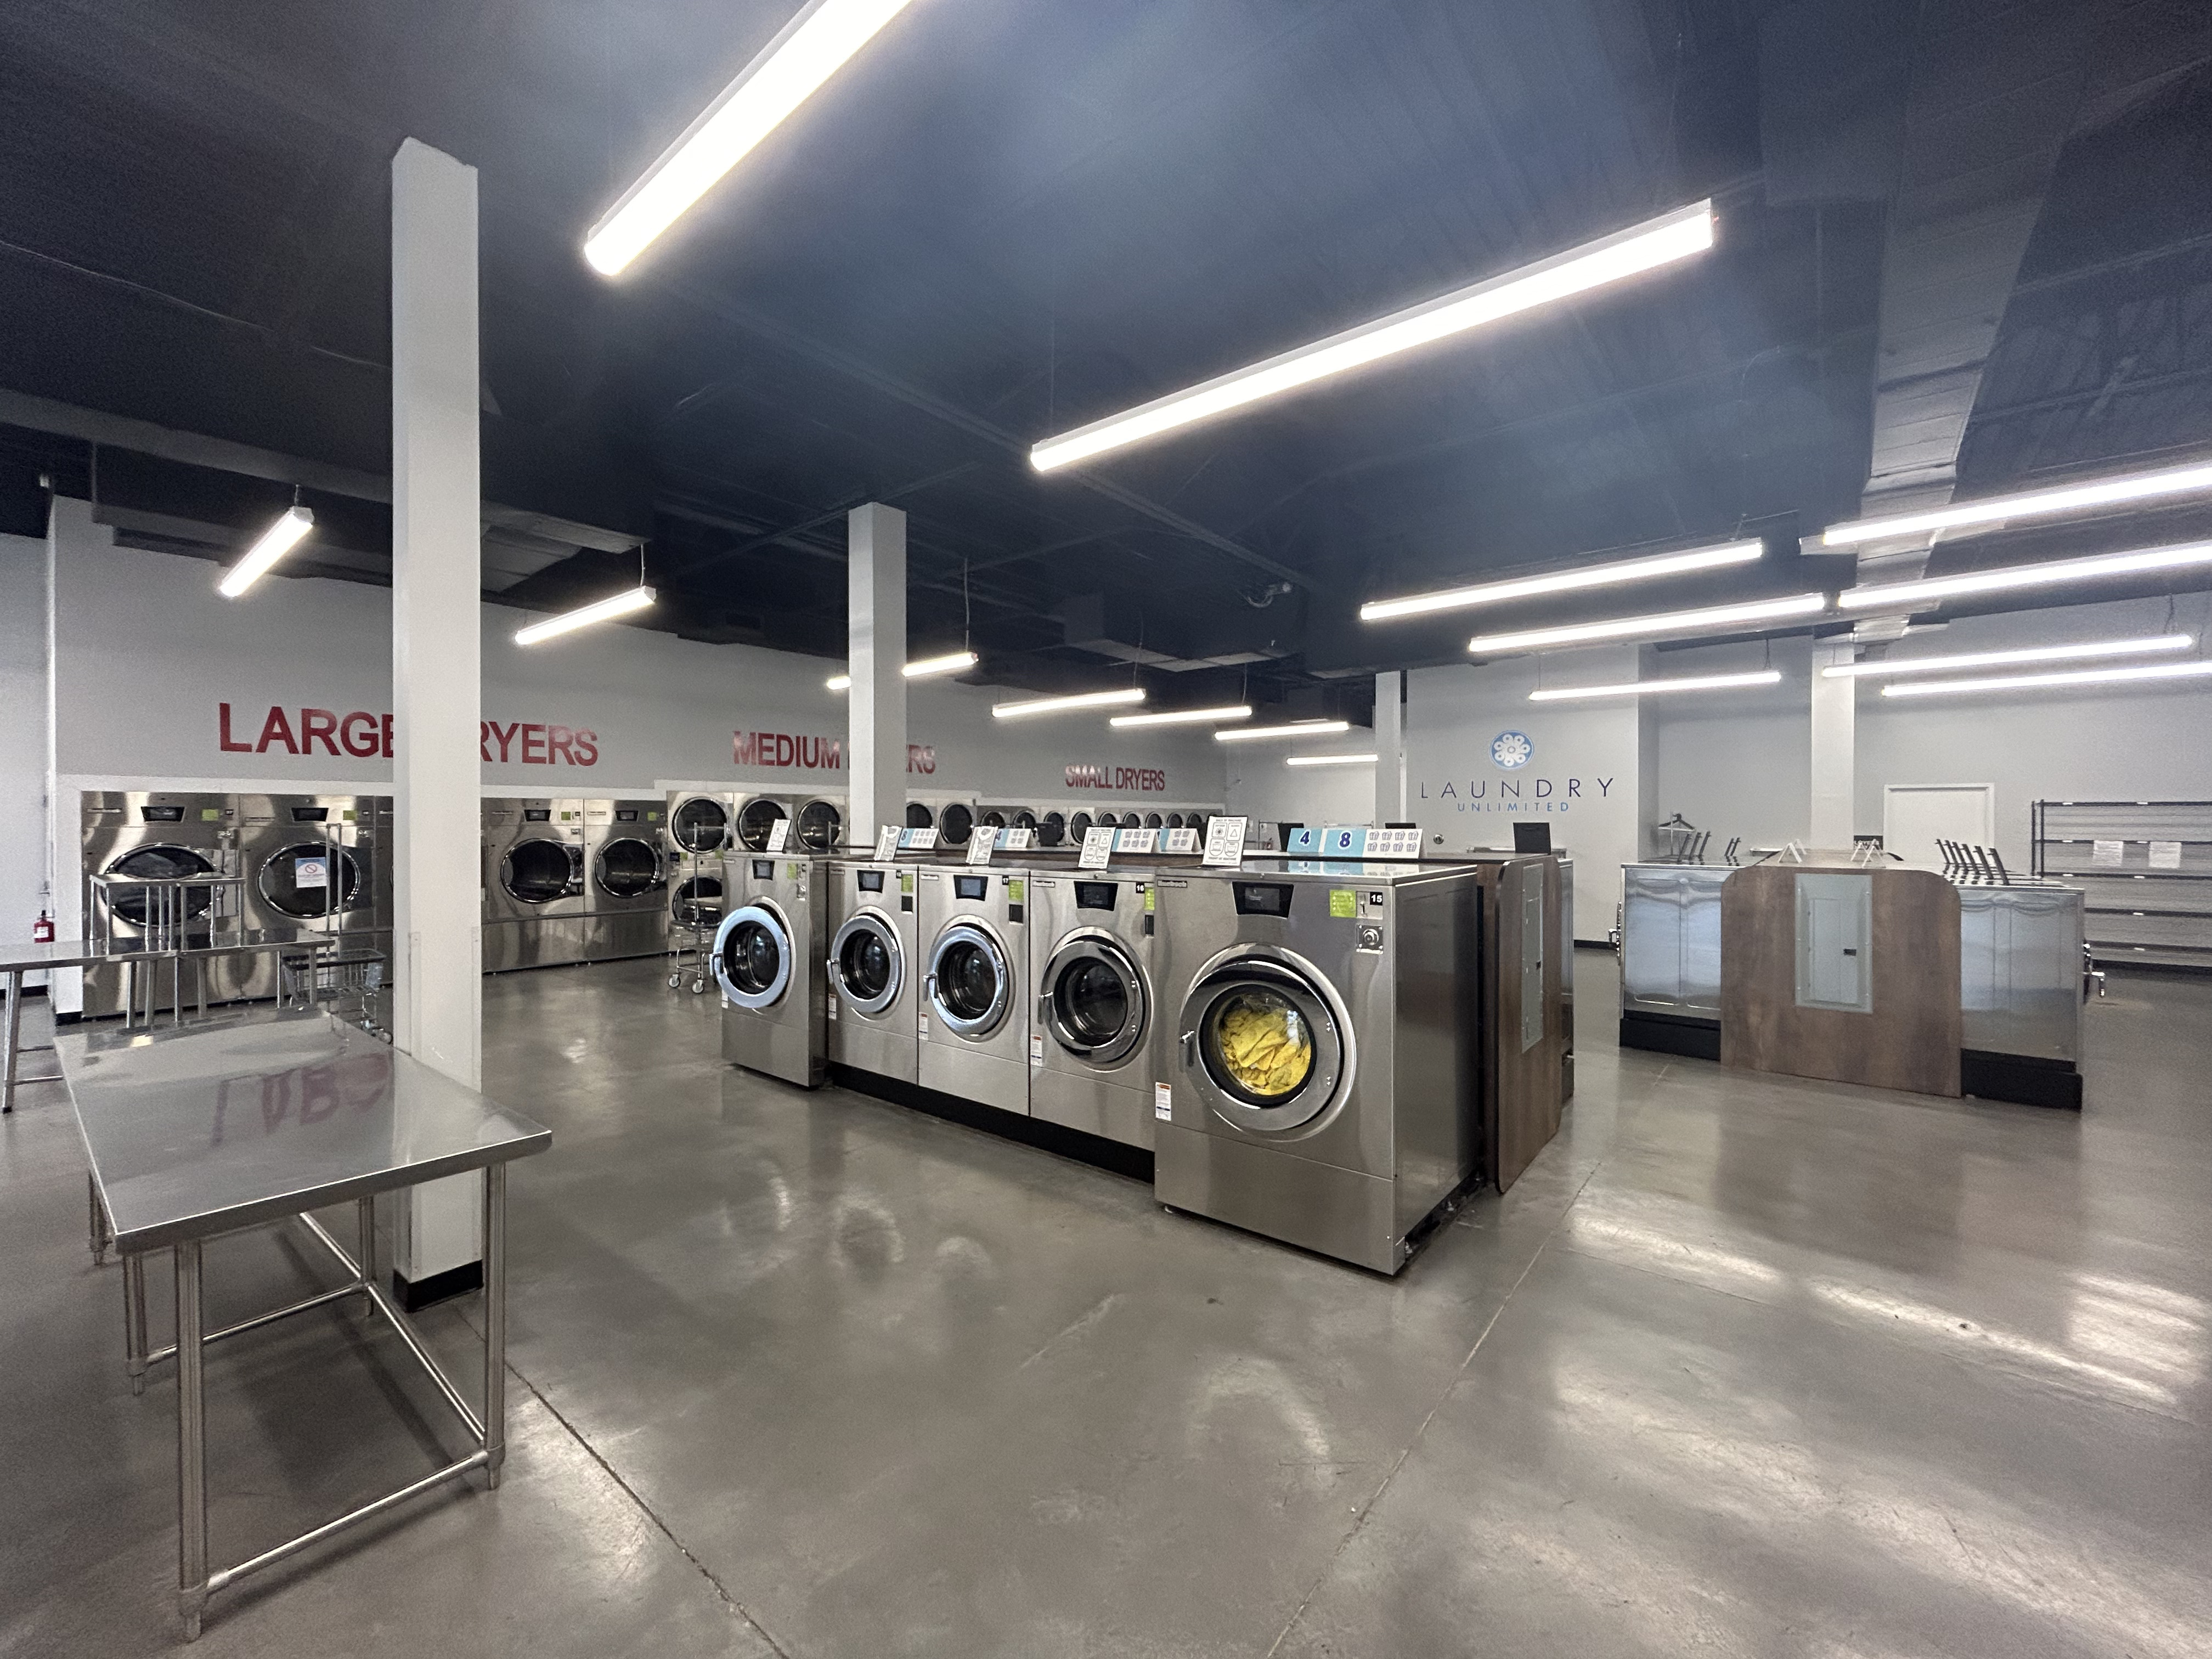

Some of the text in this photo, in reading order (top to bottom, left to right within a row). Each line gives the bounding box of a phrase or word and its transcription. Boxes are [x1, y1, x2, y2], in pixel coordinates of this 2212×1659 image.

[481, 721, 599, 766] YERS
[733, 731, 840, 769] MEDIUM
[1065, 764, 1165, 791] SMALL DRYERS
[1421, 778, 1613, 798] LAUNDRY
[1457, 802, 1569, 812] UNLIMITED
[1300, 831, 1310, 845] 4
[1339, 832, 1351, 848] 8
[1371, 894, 1383, 903] 15
